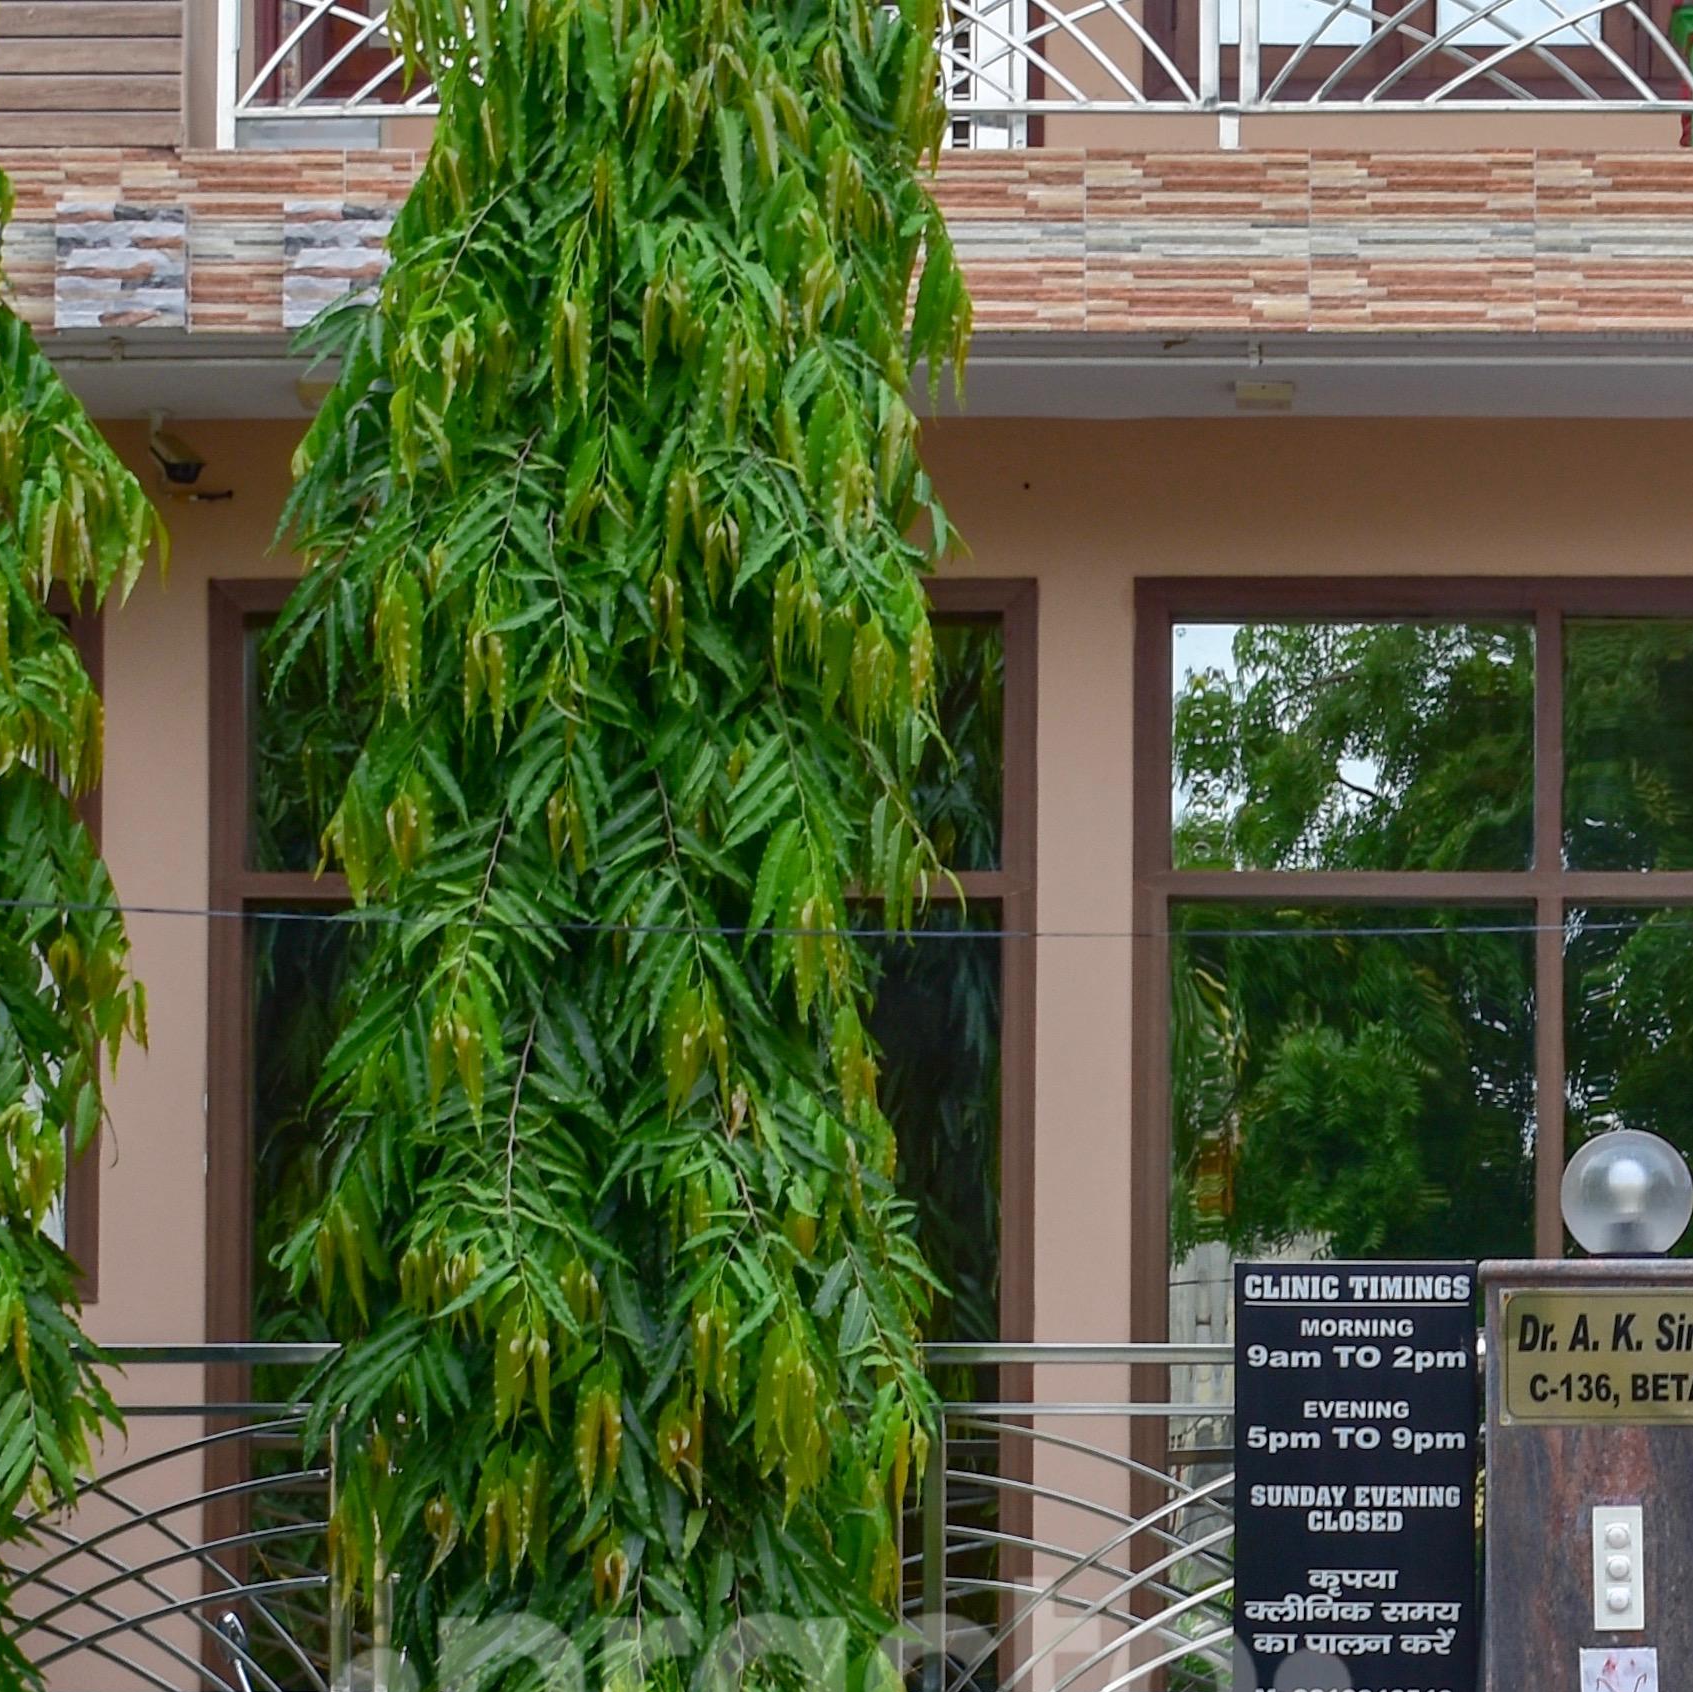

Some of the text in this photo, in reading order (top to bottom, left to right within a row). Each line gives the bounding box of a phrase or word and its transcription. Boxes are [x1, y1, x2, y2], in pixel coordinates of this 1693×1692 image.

[1244, 1274, 1471, 1300] CLINIC TIMINGS
[1300, 1319, 1414, 1337] MORNING
[1518, 1313, 1558, 1351] Dr.
[1568, 1313, 1600, 1351] A.
[1611, 1313, 1643, 1351] K.
[1247, 1344, 1467, 1373] 9am TO 2pm
[1529, 1373, 1620, 1408] C-136,
[1303, 1401, 1410, 1418] EVENING
[1247, 1425, 1466, 1454] 5pm TO 9pm
[1250, 1485, 1461, 1508] SUNDAY EVENING
[1308, 1510, 1404, 1532] CLOSED
[1308, 1569, 1399, 1597] कृपया
[1244, 1593, 1461, 1622] क्लीनिक समय
[1252, 1627, 1456, 1655] का पालन करें
